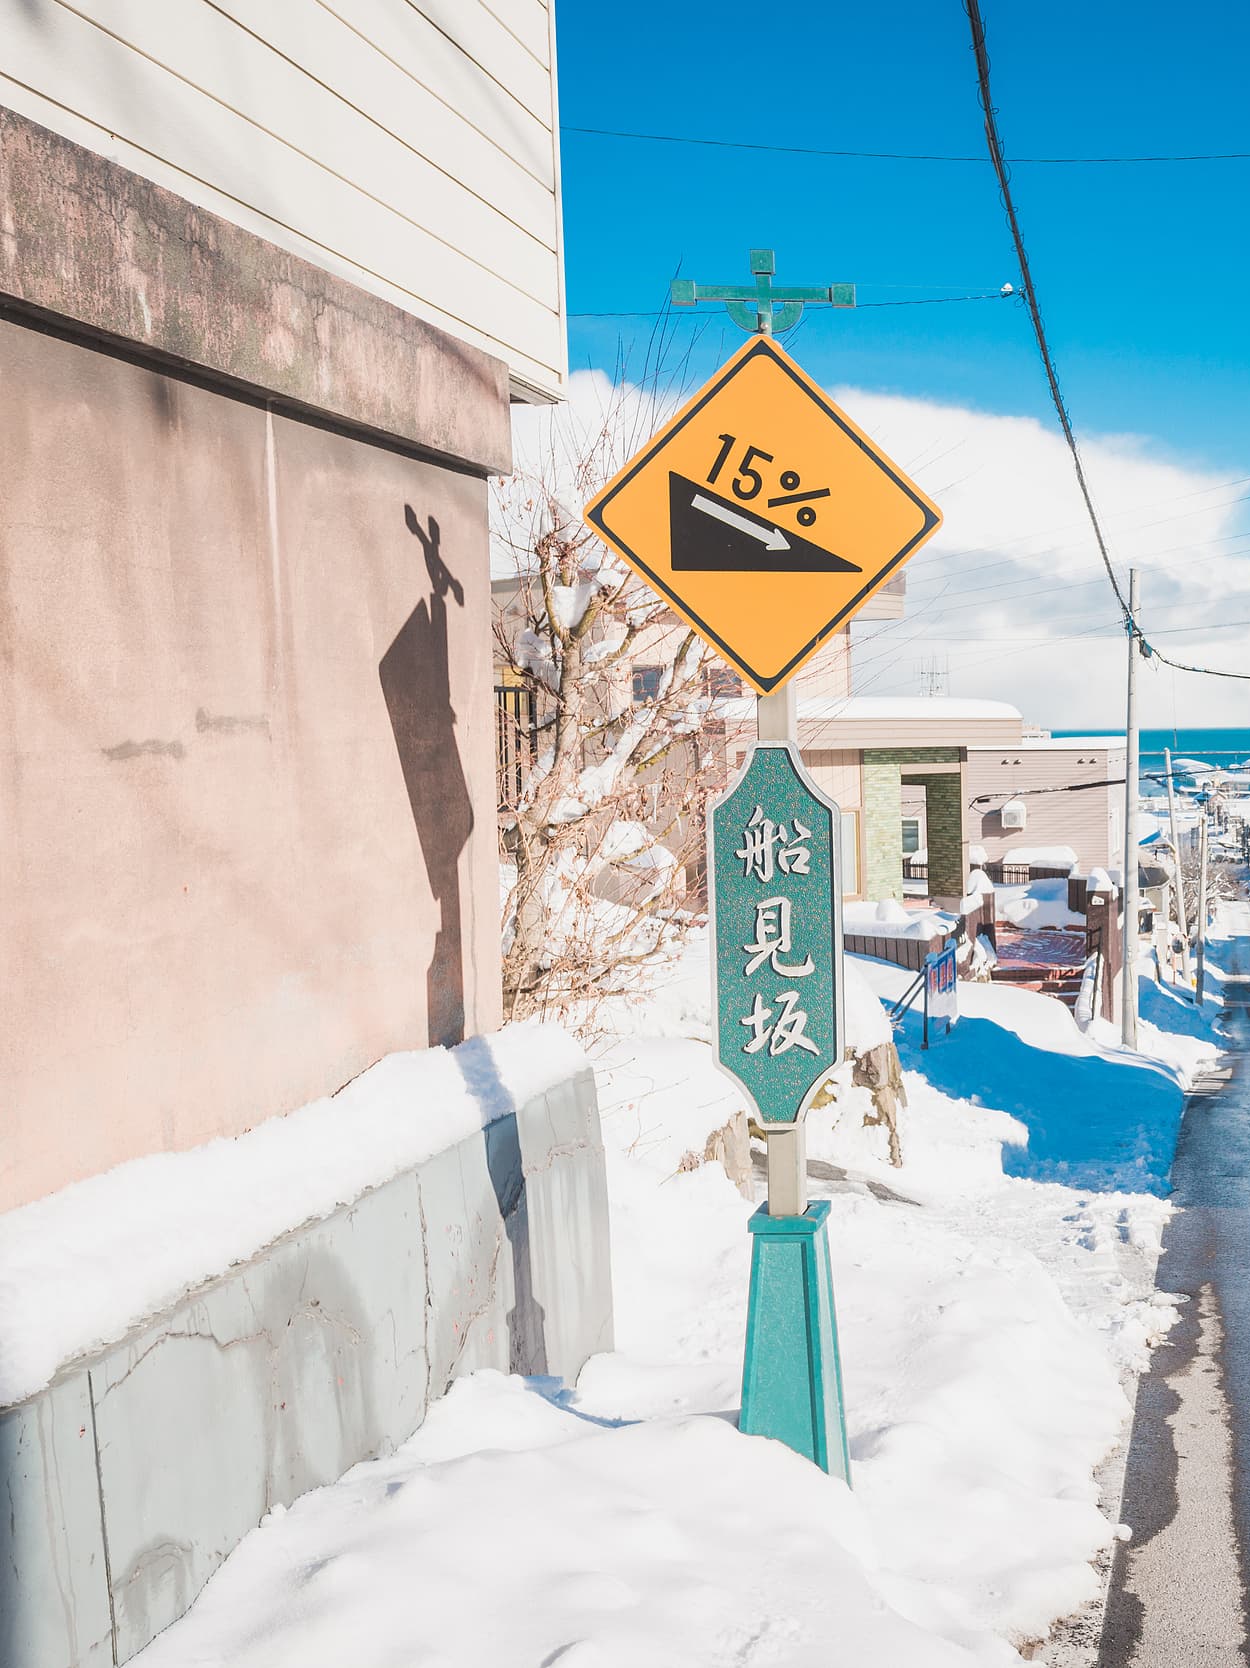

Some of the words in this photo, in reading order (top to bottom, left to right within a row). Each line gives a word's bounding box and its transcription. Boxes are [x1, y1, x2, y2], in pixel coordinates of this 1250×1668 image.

[706, 433, 830, 527] 15%
[735, 805, 821, 1057] 船見坂
